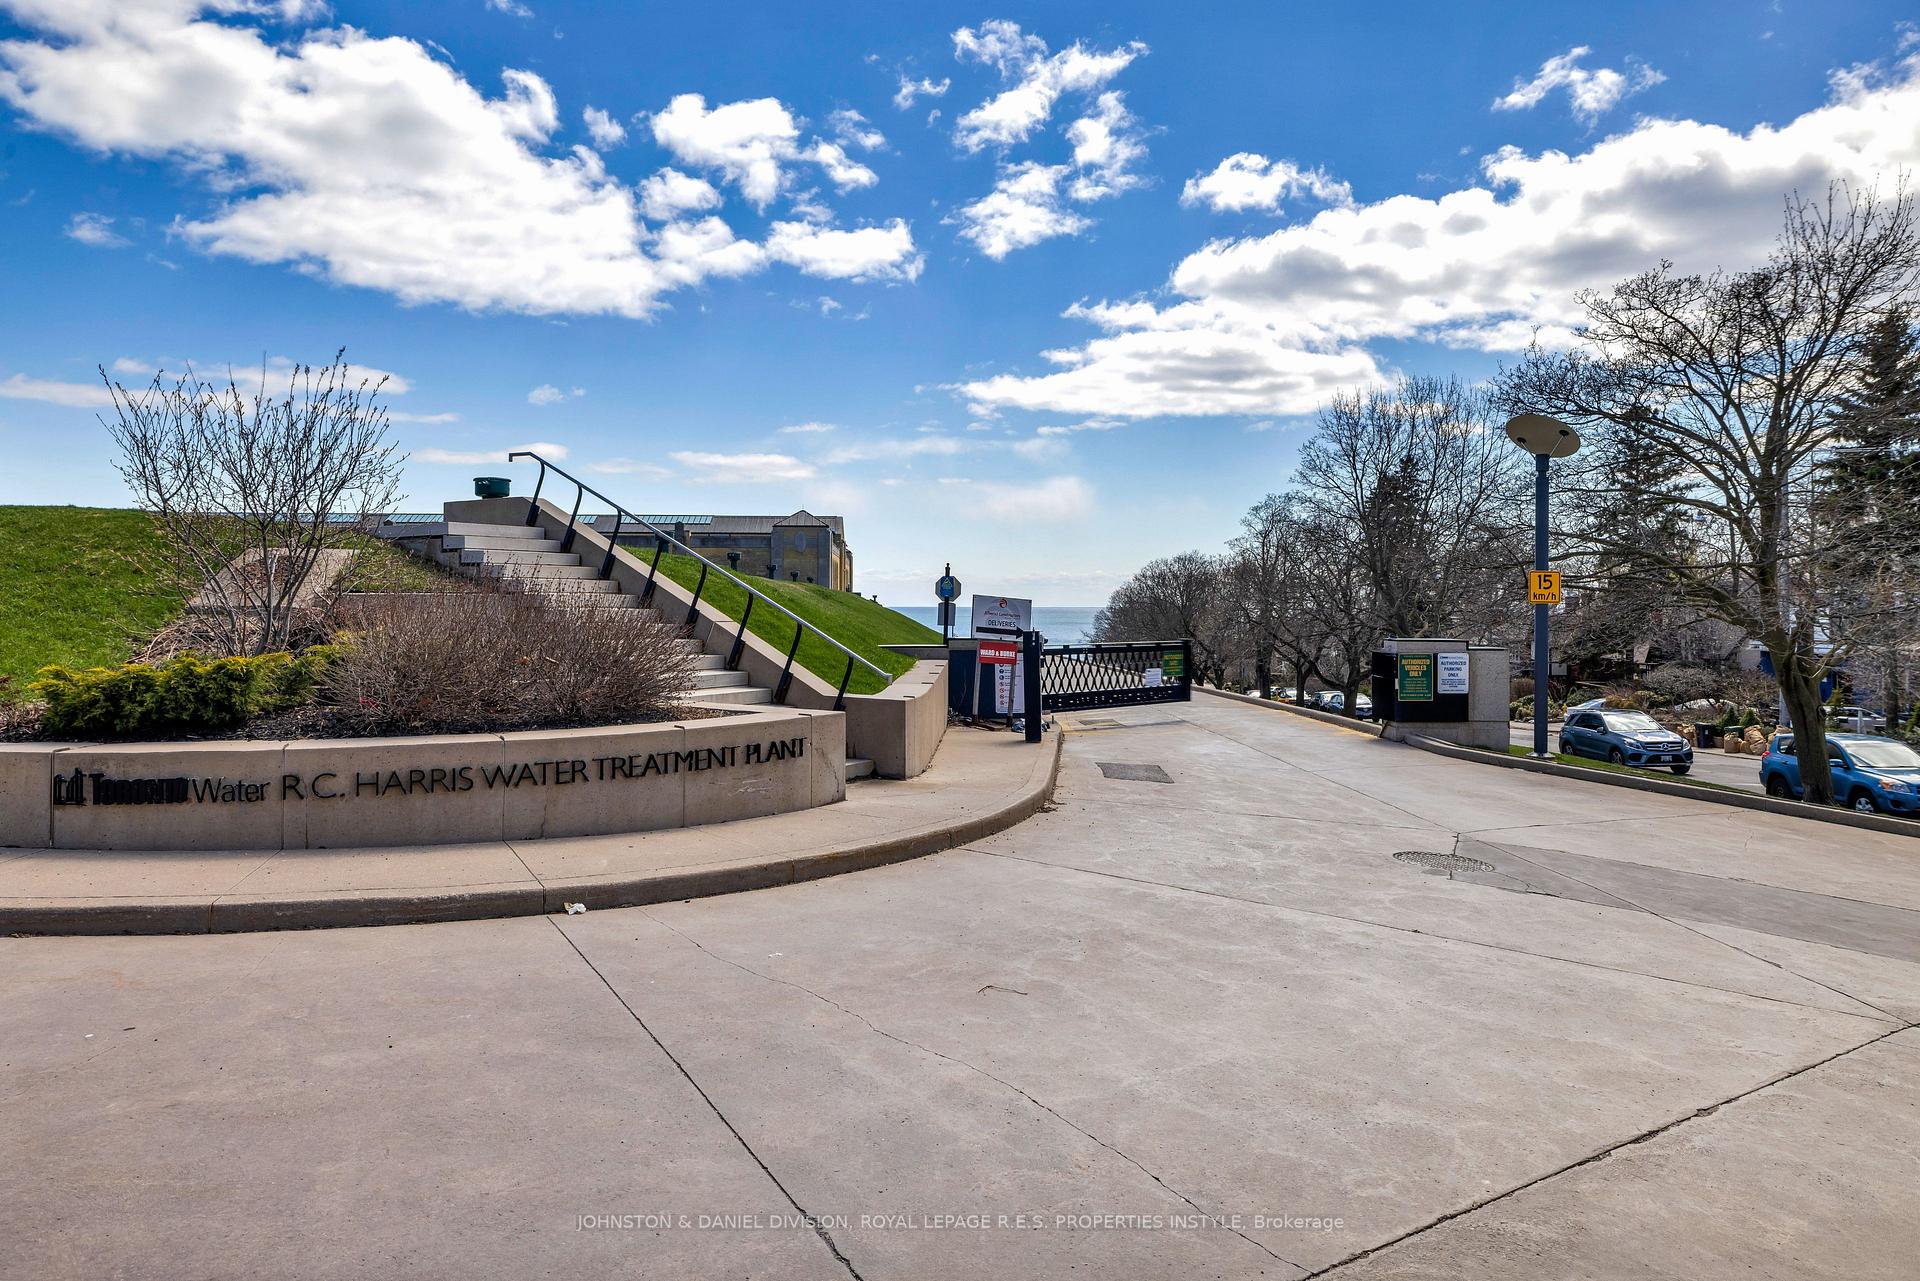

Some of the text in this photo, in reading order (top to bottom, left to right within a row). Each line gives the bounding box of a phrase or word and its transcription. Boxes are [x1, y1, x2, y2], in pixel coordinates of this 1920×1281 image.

[1537, 574, 1553, 590] 15
[1533, 592, 1557, 601] km/h
[988, 619, 1016, 628] DELIVERIES
[192, 777, 271, 803] Water
[355, 766, 475, 797] HARRIS
[481, 759, 590, 789] WATER
[592, 745, 741, 781] TREATMENT
[745, 737, 808, 765] PLANT
